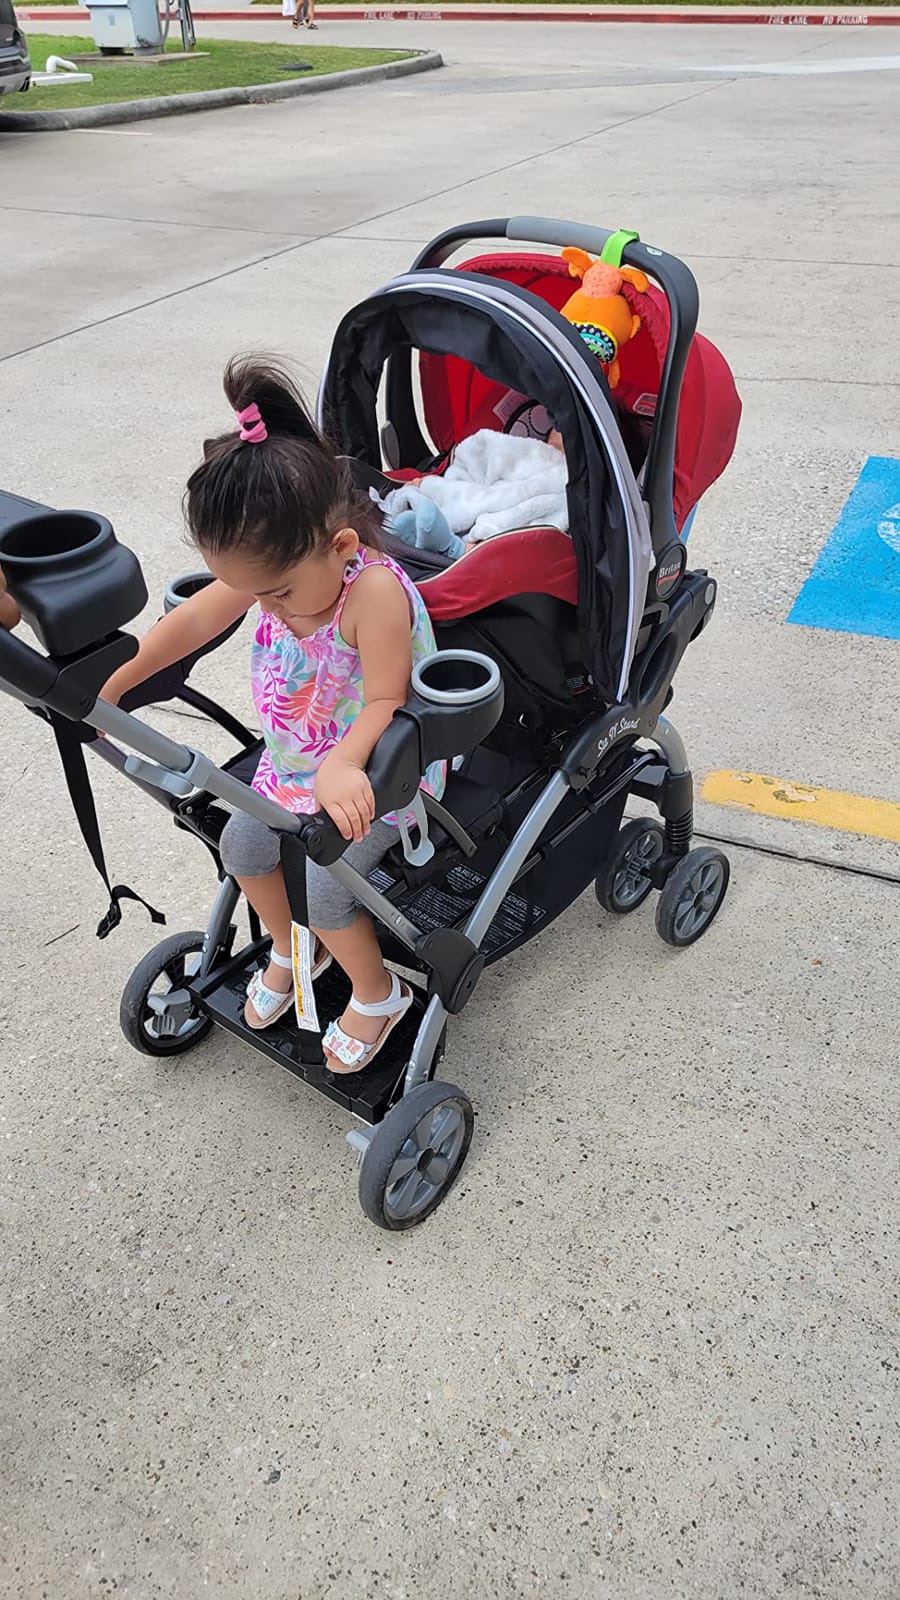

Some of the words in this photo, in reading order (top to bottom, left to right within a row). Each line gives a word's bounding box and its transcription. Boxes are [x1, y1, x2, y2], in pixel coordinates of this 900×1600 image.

[768, 15, 785, 25] FIRE
[788, 15, 808, 25] LANE
[822, 15, 834, 25] NO
[836, 15, 868, 25] PARKING
[659, 562, 681, 578] Britax
